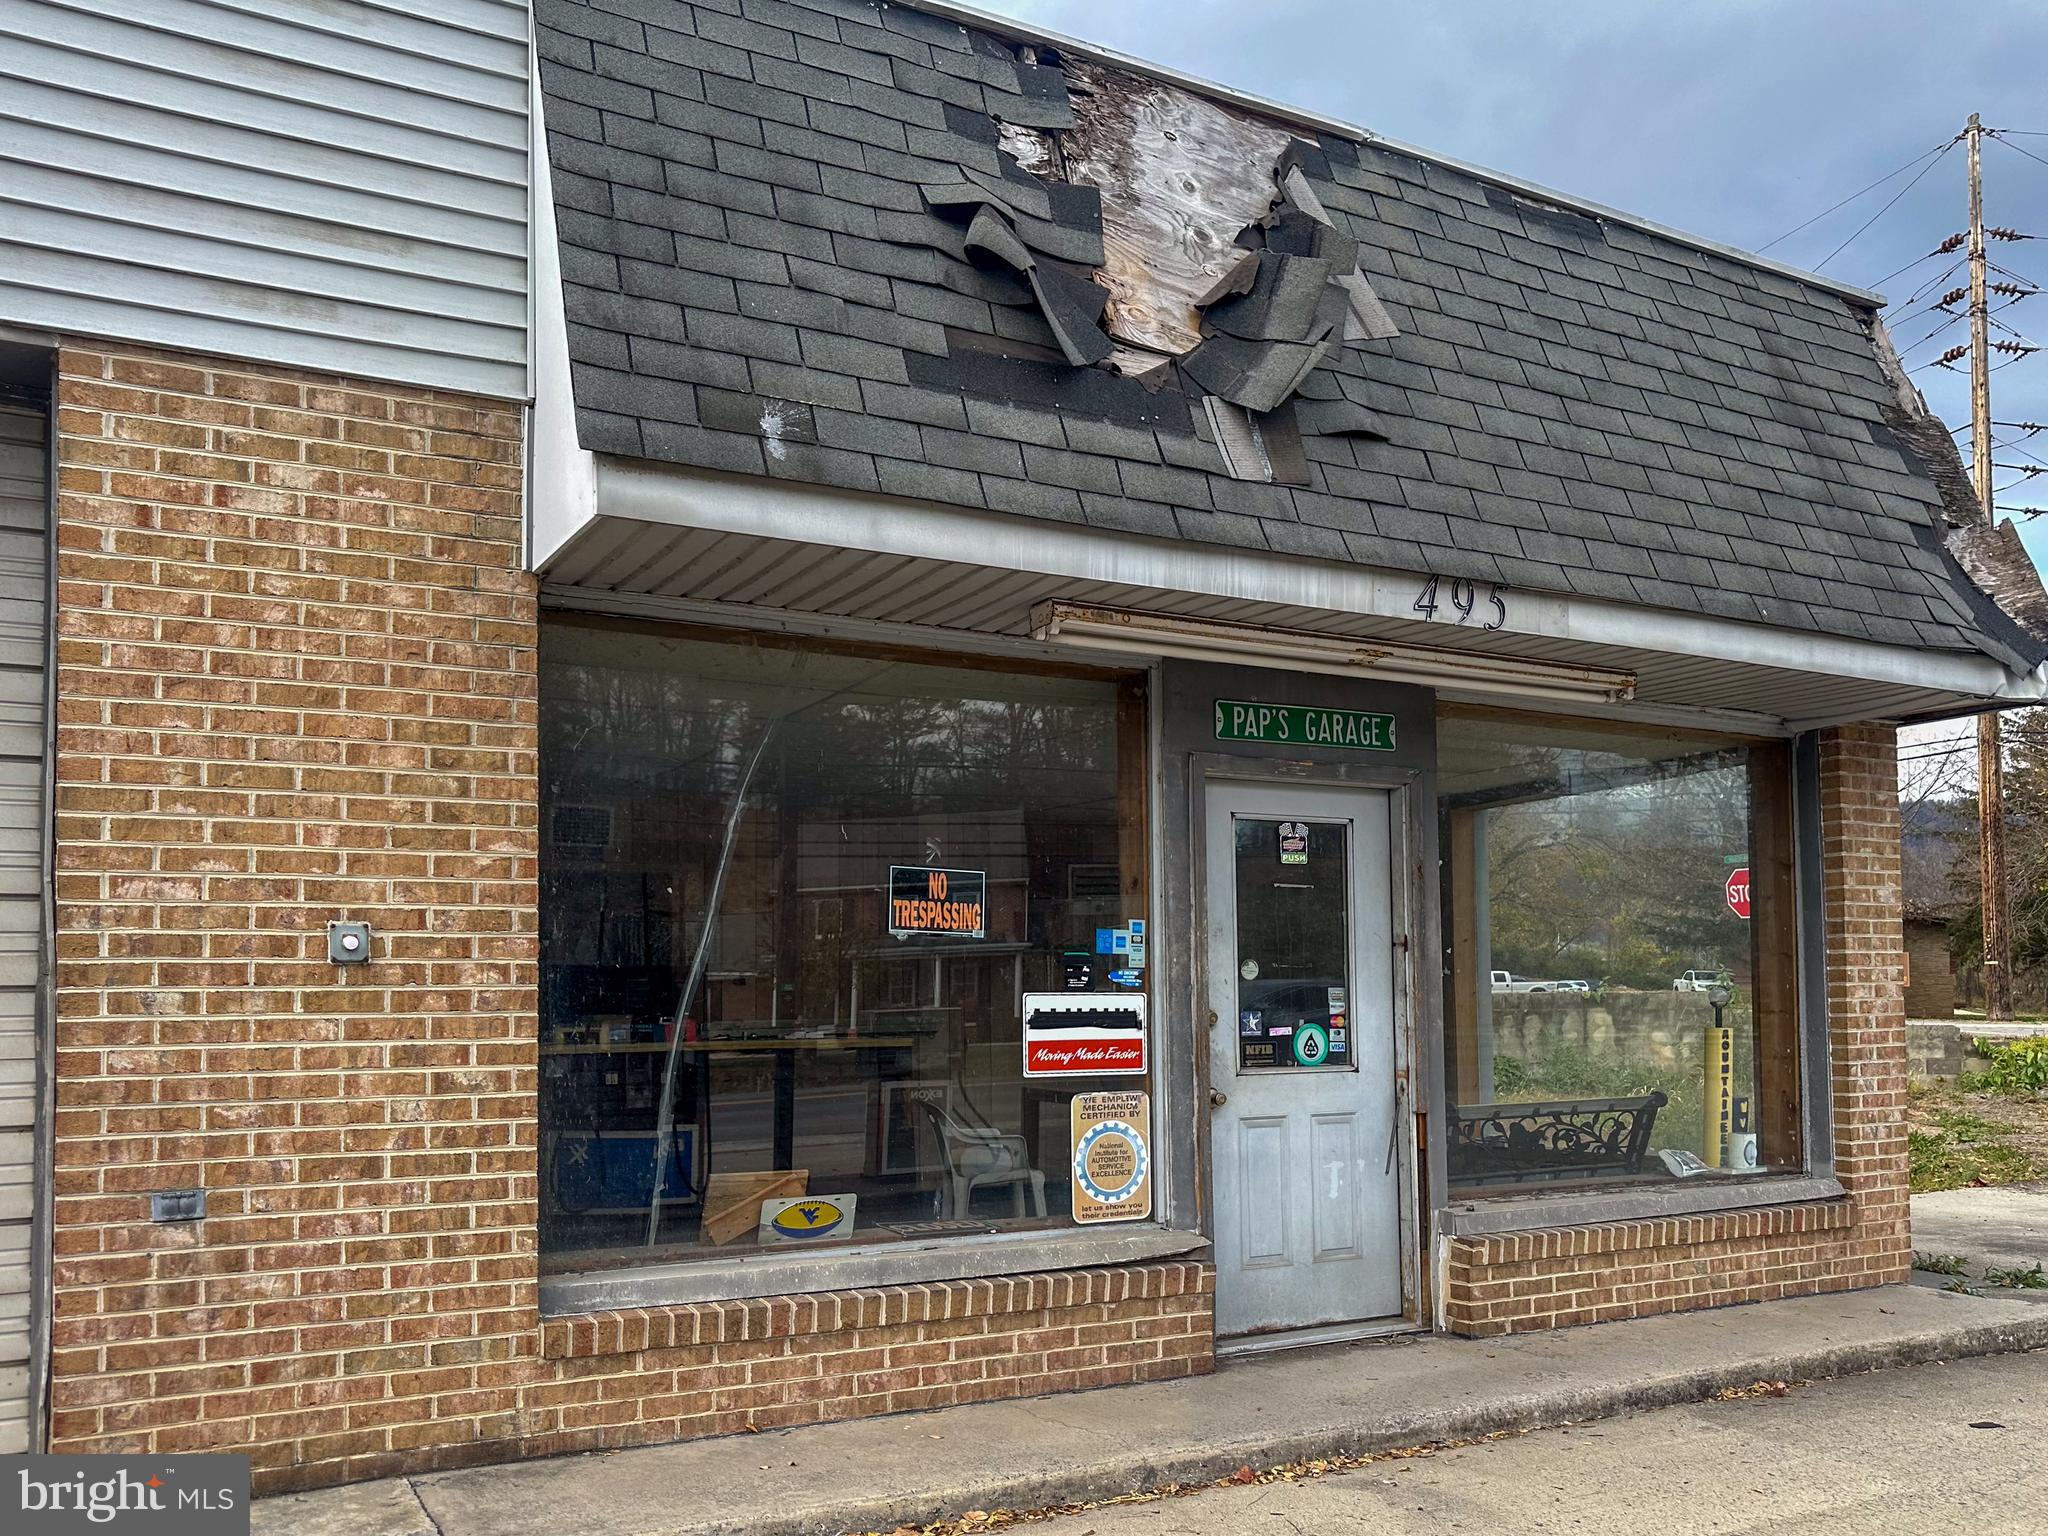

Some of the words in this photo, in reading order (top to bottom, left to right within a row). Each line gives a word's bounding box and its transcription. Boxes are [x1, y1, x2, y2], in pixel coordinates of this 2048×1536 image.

[1412, 573, 1509, 632] 495
[1233, 706, 1289, 739] PAP'S
[1305, 711, 1382, 746] GARAGE
[1282, 854, 1306, 862] PUSH
[928, 872, 948, 900] NO
[1729, 885, 1750, 903] STO
[893, 899, 981, 930] TRESPASSING
[1032, 1048, 1074, 1065] Moving
[1072, 1047, 1106, 1060] Made
[1105, 1046, 1140, 1060] Easier
[1331, 1043, 1345, 1051] VISA
[1080, 1111, 1126, 1120] CERTIFIED
[1129, 1110, 1141, 1118] BY
[1091, 1169, 1132, 1178] EXCELLENCE
[1129, 1202, 1143, 1210] you
